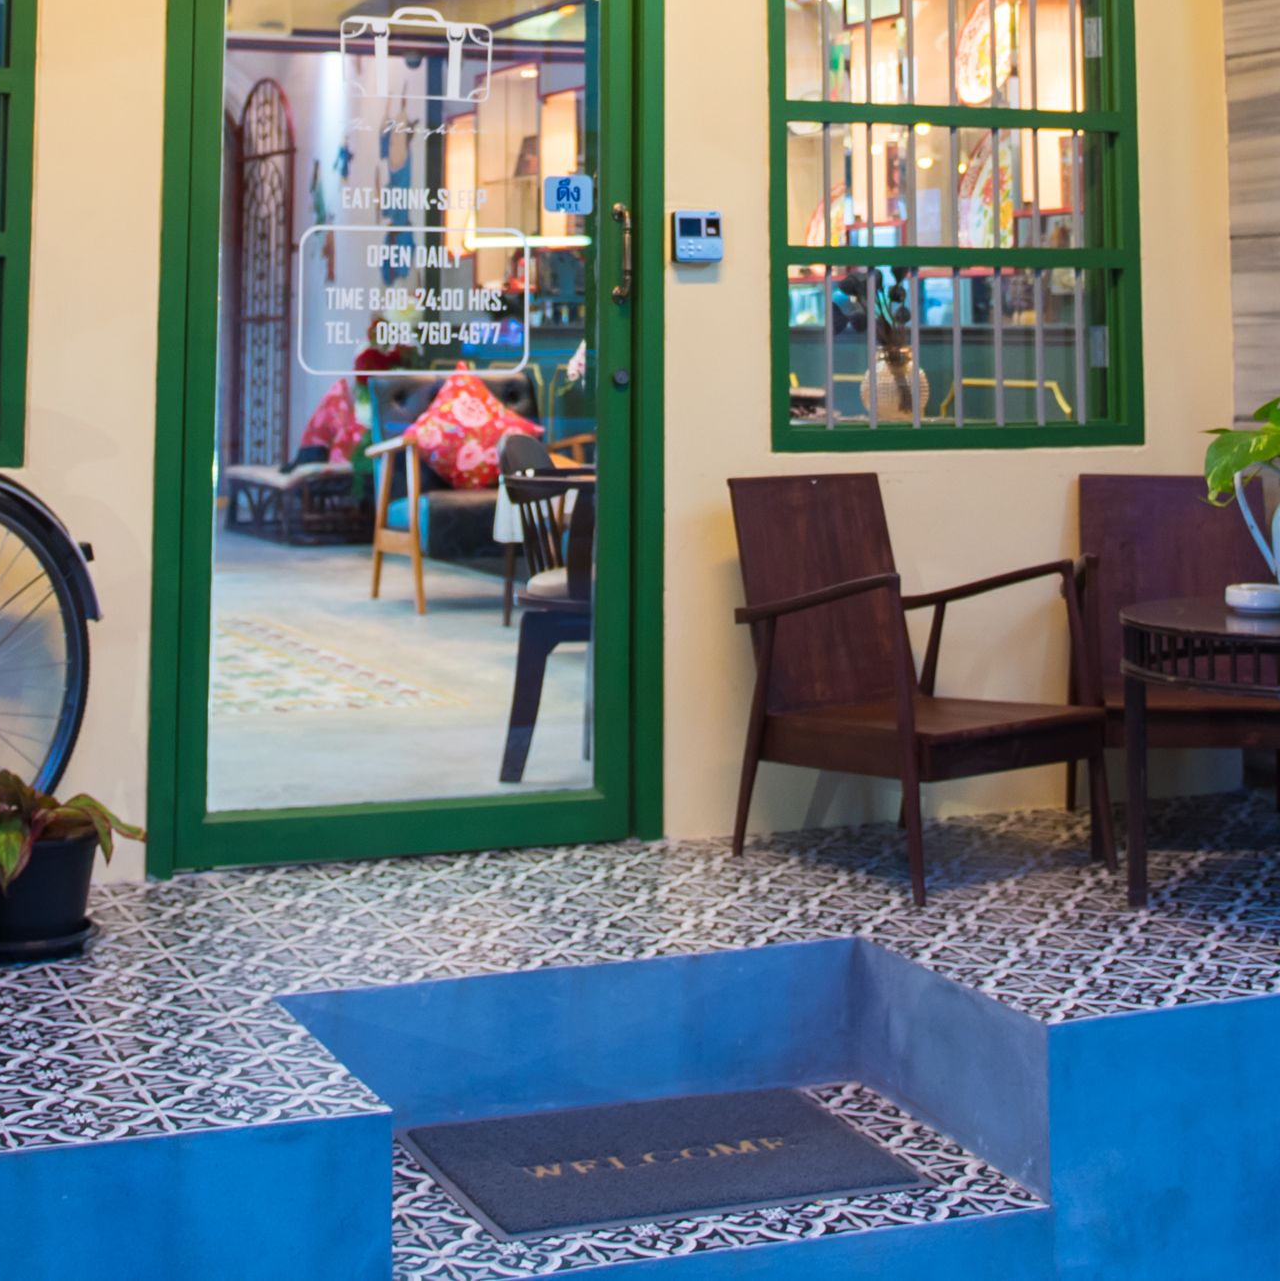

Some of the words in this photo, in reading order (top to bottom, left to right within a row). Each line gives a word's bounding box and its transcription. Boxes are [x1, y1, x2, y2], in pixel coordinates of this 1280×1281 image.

[342, 187, 489, 212] EAT-DRINK-SLEEP
[556, 177, 581, 202] ดึง
[367, 245, 411, 268] OPEN
[416, 245, 463, 268] DAILY
[325, 287, 364, 311] TIME
[369, 287, 464, 312] 8:00-24:00
[468, 288, 508, 312] HRS.
[325, 322, 361, 345] TEL.
[376, 322, 502, 346] 088-760-4677
